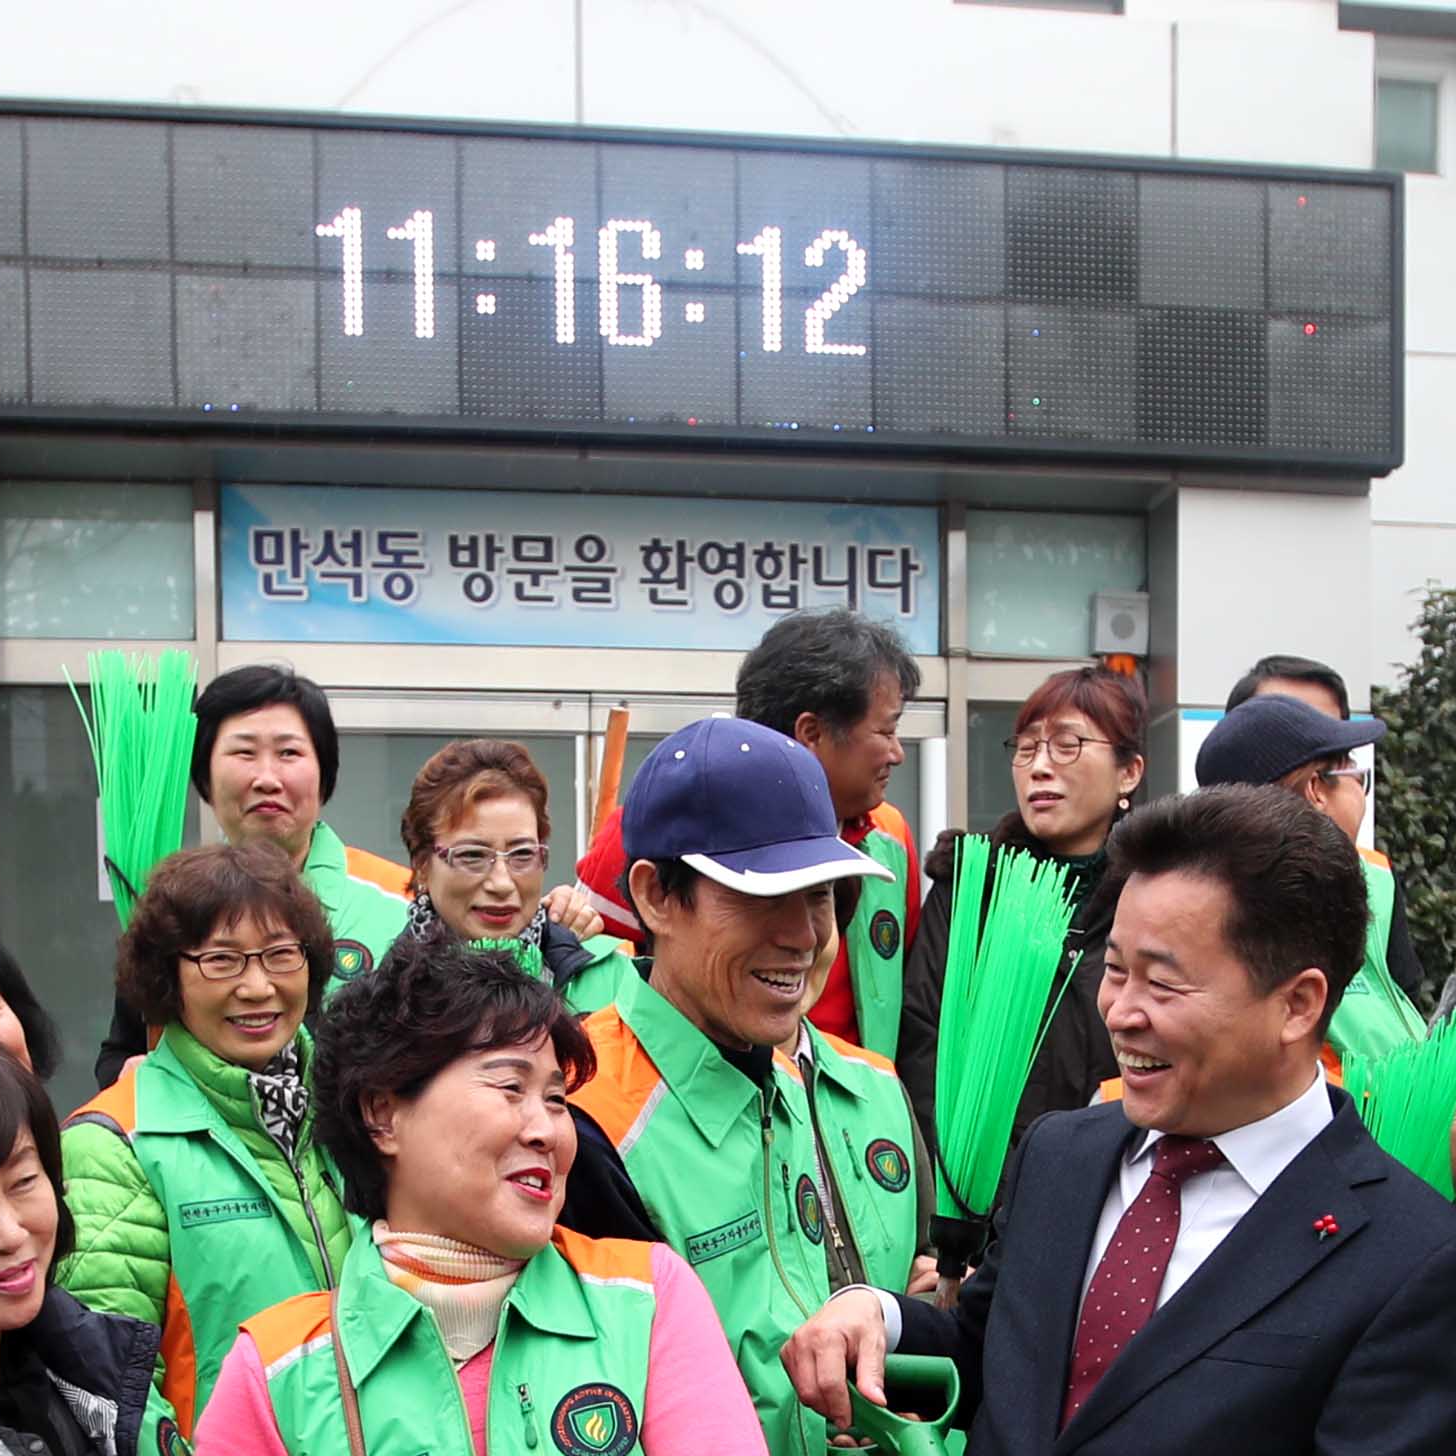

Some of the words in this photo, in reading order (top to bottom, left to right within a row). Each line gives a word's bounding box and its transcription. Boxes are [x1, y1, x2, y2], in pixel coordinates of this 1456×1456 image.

[315, 206, 867, 356] 11:16:12
[252, 527, 427, 603] 만석동
[448, 533, 618, 604] 방문을
[639, 537, 921, 615] 환영합니다
